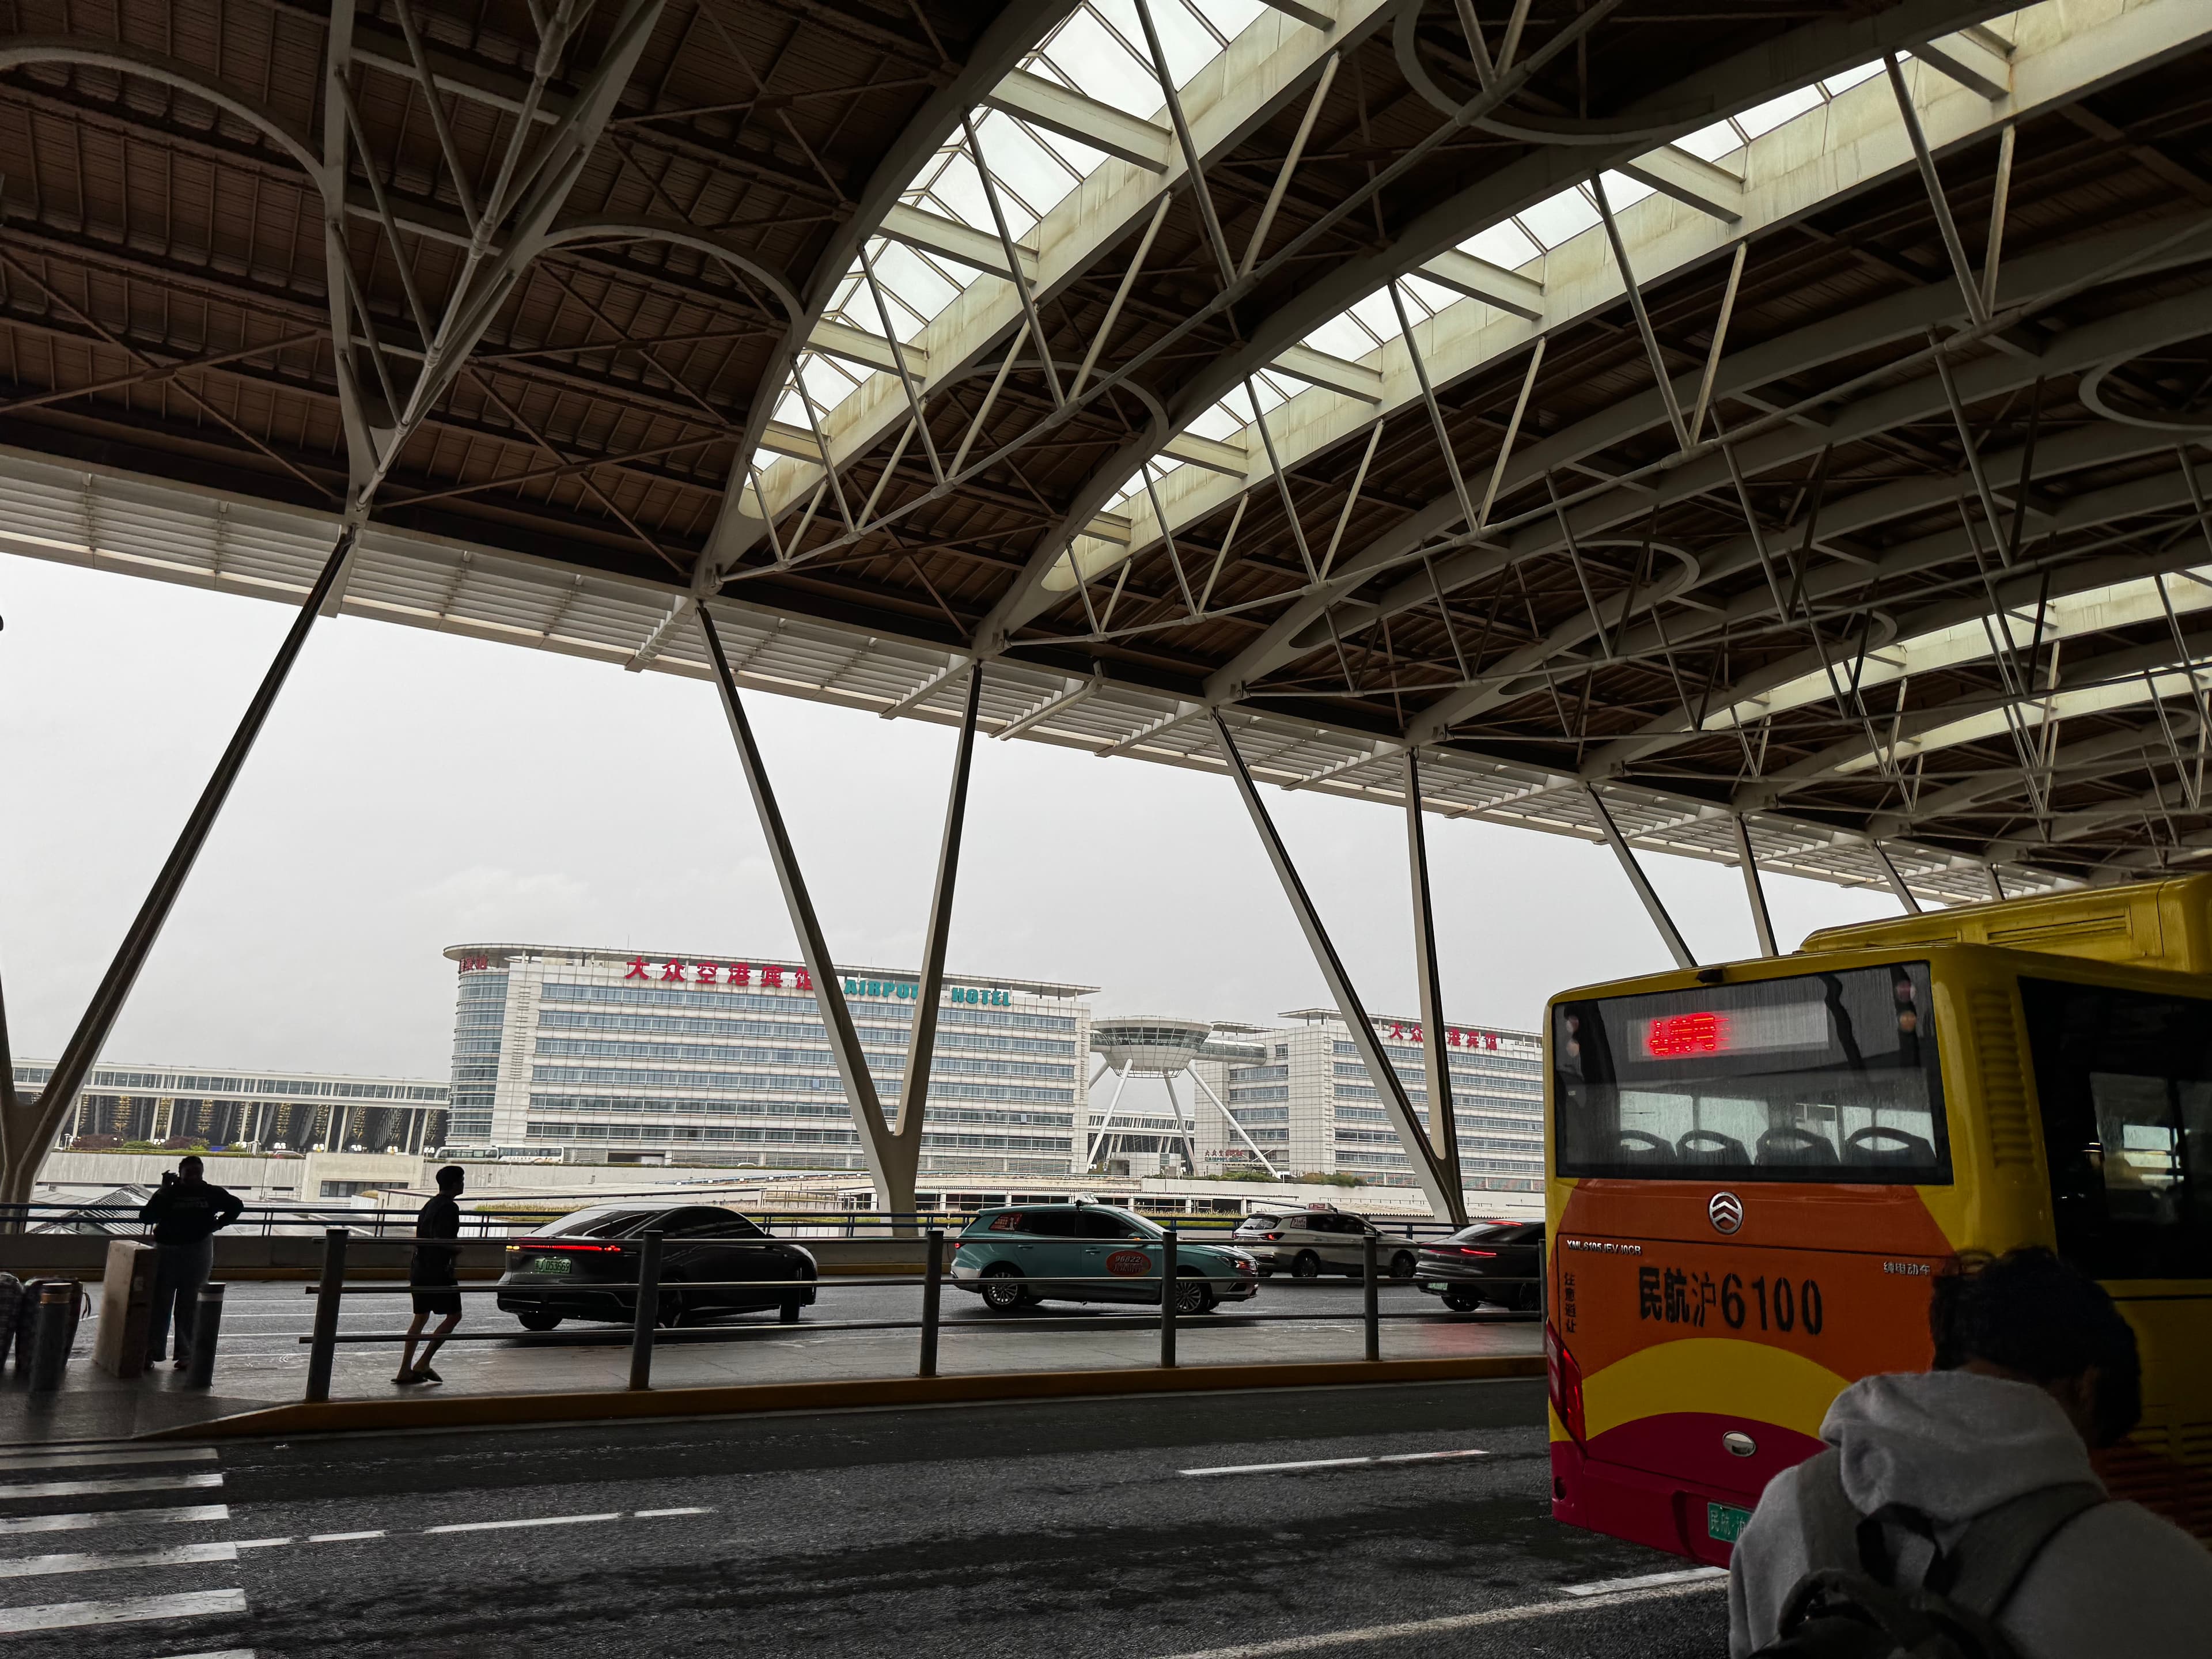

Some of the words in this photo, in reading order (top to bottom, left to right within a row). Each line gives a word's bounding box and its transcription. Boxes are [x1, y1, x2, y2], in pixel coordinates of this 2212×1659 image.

[844, 979, 918, 999] AIRPO
[952, 987, 1012, 1006] HOTEL
[1389, 1022, 1497, 1051] 大众港宾馆
[1884, 1262, 1930, 1275] 纯电动车
[1639, 1267, 1823, 1335] 民航沪6100
